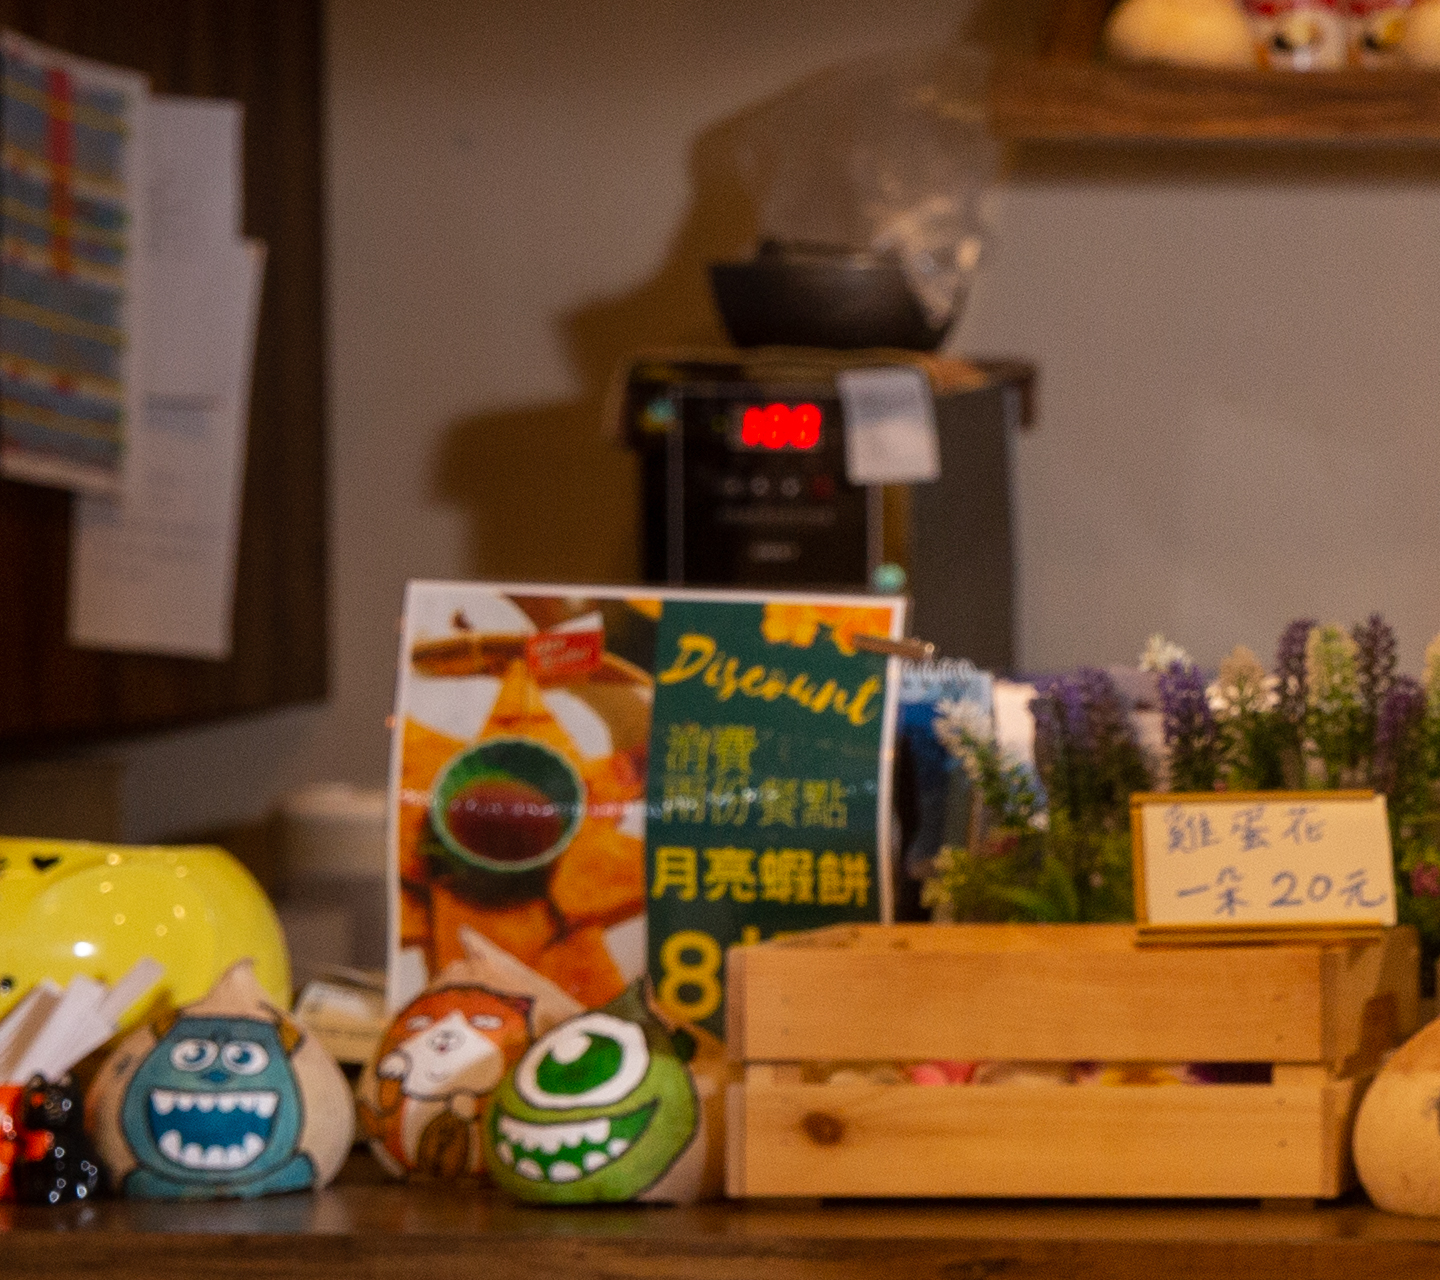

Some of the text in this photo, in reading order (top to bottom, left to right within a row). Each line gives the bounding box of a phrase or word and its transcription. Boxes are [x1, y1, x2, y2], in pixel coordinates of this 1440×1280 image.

[658, 632, 882, 727] Discount
[651, 845, 872, 907] 月亮蝦餅
[1268, 869, 1388, 909] 20元
